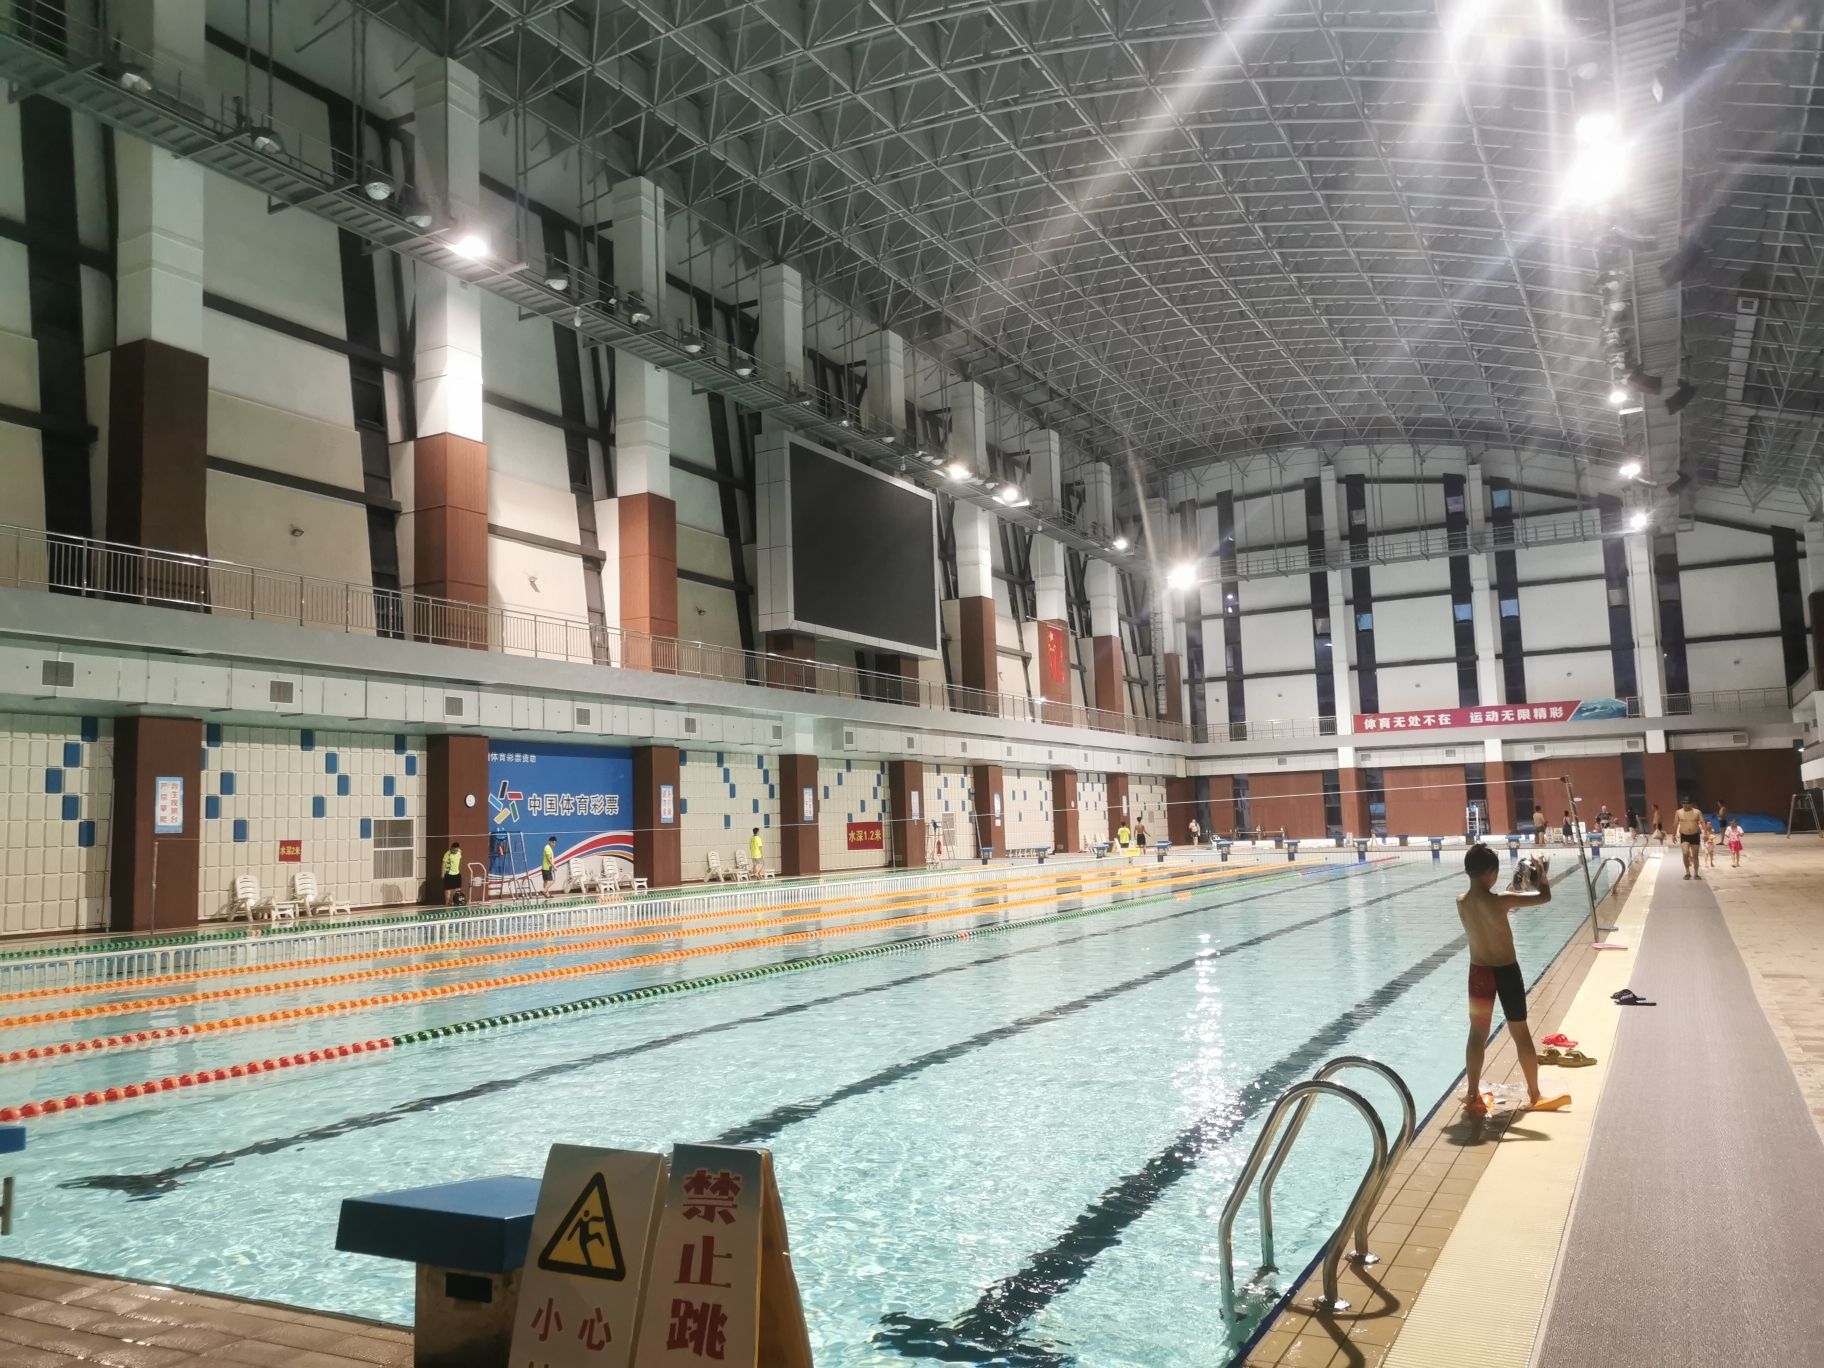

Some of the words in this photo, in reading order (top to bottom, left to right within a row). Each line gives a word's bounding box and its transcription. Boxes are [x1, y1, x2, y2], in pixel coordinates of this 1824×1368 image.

[1364, 714, 1451, 731] 体育无处不在
[1469, 707, 1564, 725] 运动无限精彩
[488, 752, 537, 764] 体育彩票资助
[528, 793, 619, 816] 中国体育彩票
[848, 829, 882, 843] 水深1.2米
[666, 1169, 742, 1361] 禁止跳
[530, 1297, 613, 1351] 小心
